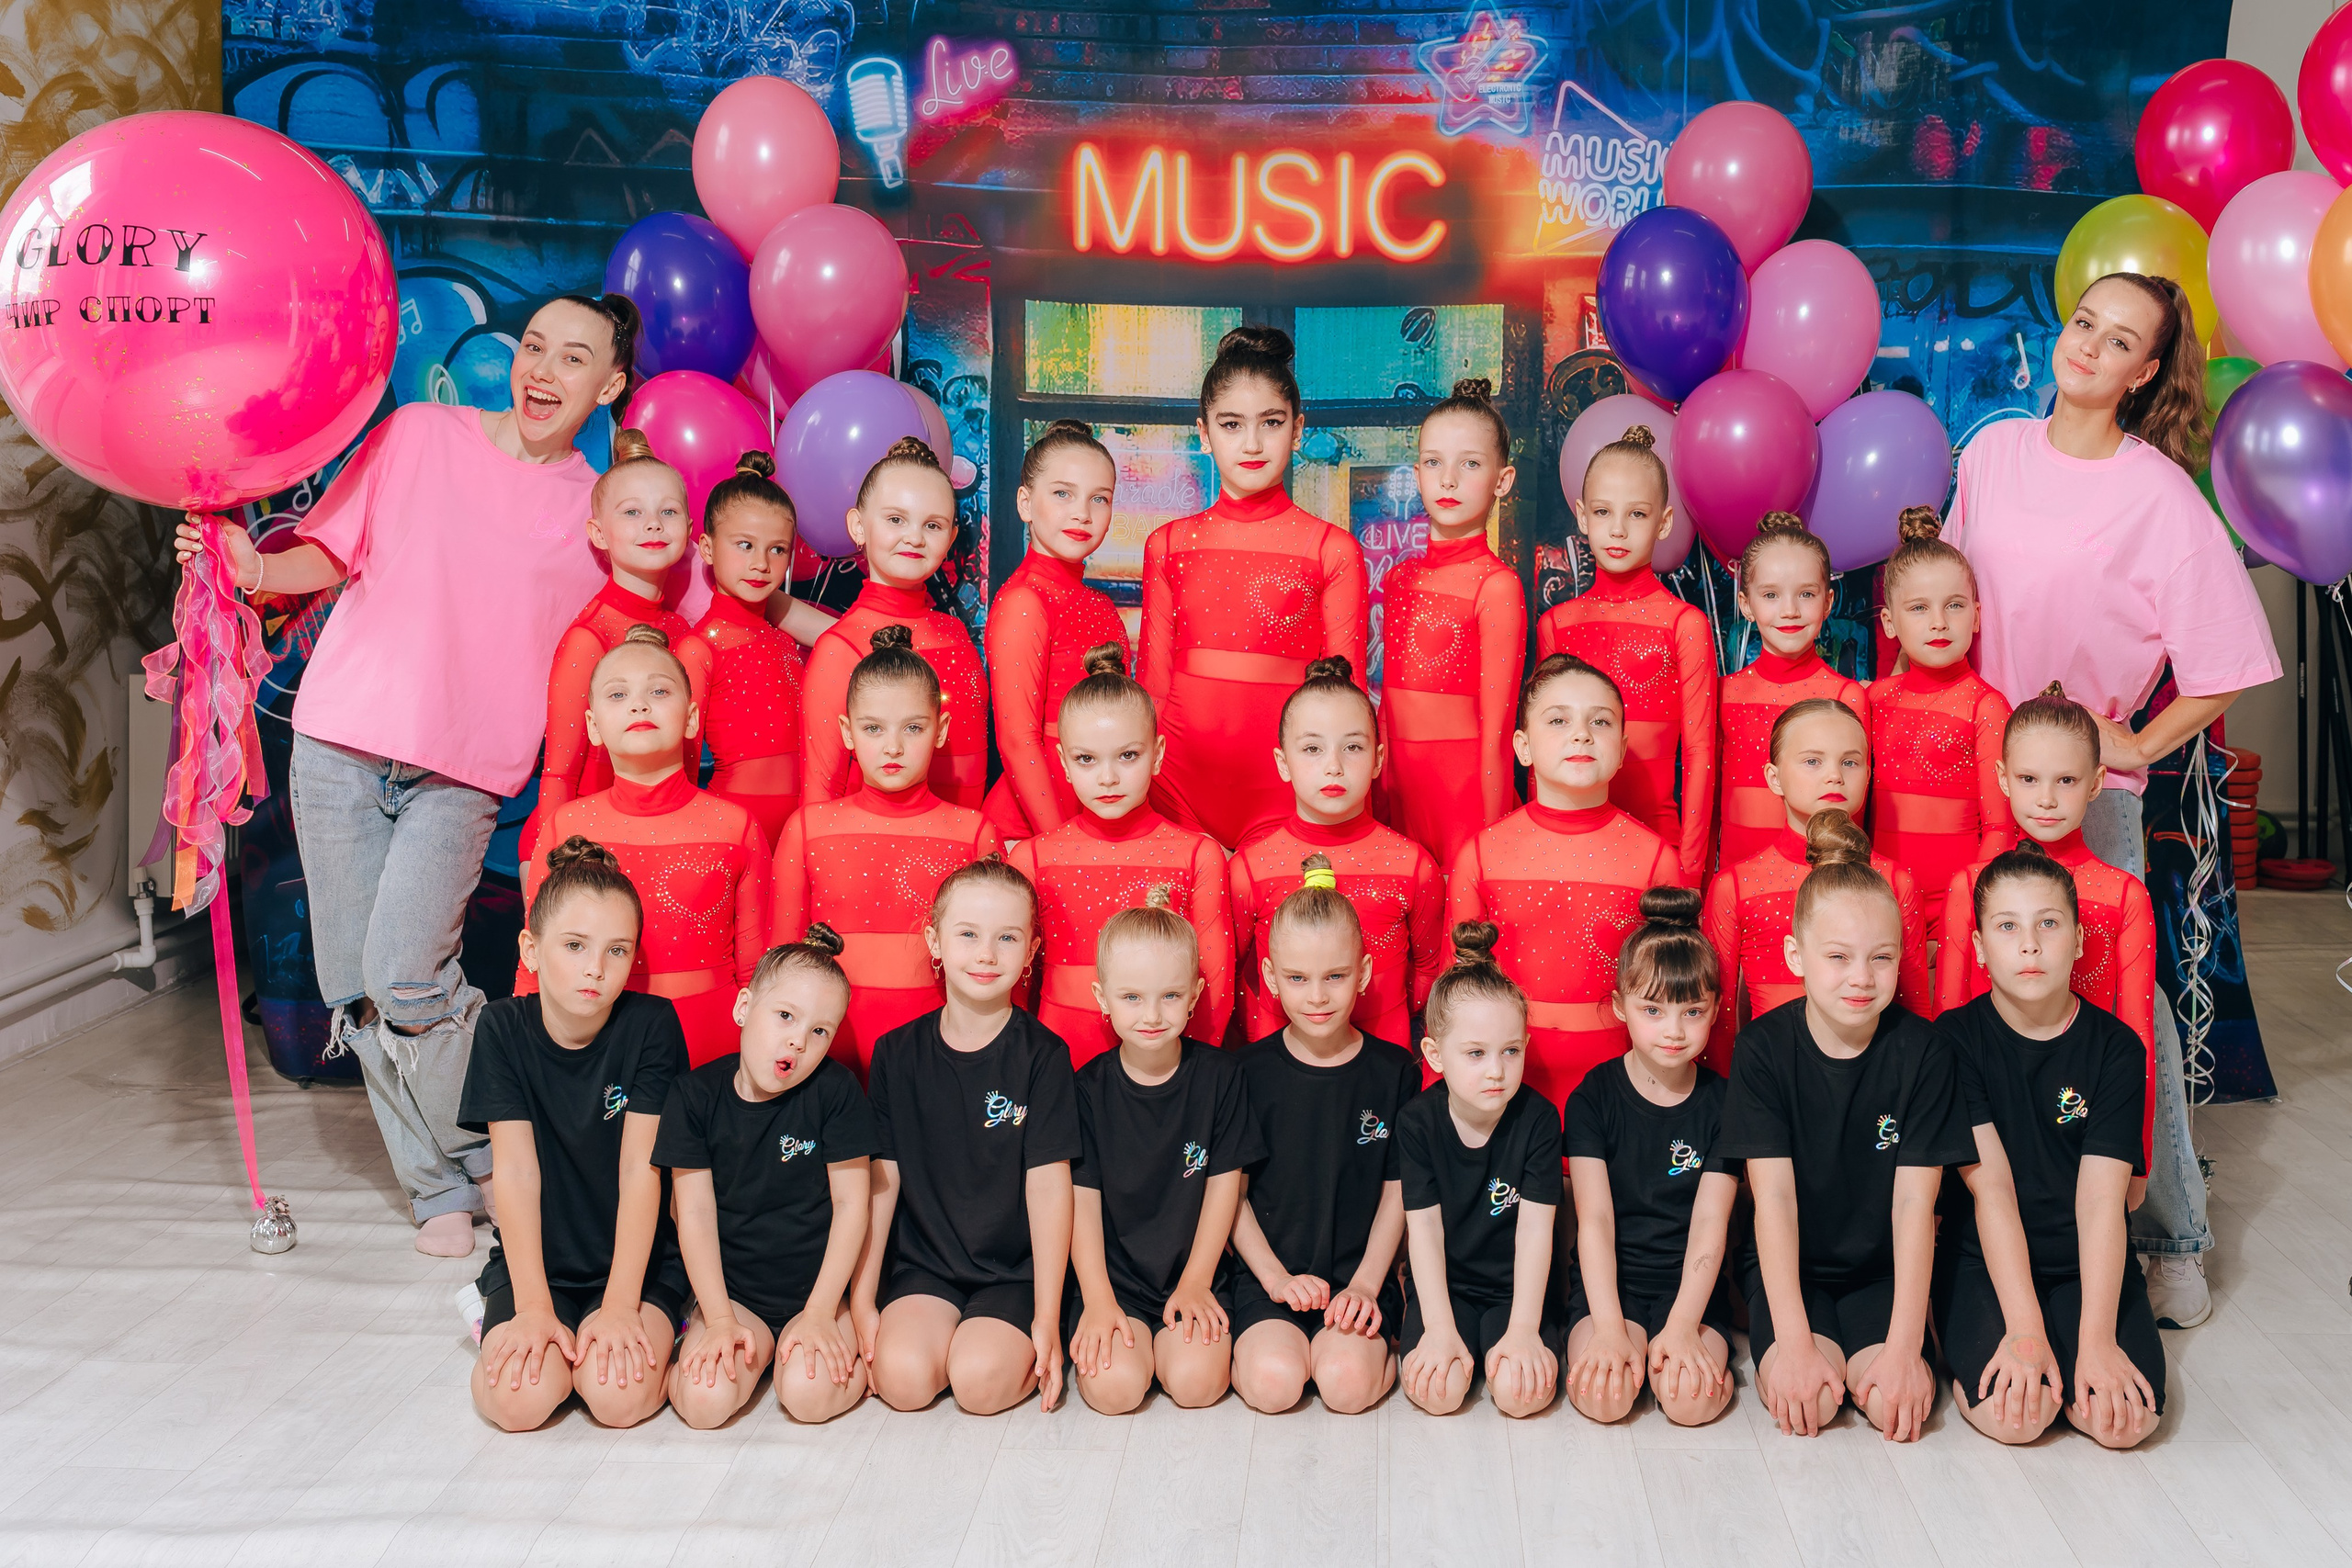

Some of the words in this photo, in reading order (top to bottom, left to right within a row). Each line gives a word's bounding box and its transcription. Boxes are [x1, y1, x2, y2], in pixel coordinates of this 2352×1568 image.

[922, 39, 1013, 116] Live
[1477, 84, 1522, 94] ELECTRONIC
[1488, 95, 1511, 104] MUSIC
[1541, 130, 1674, 186] MUSI
[1074, 143, 1445, 260] MUSIC
[1538, 178, 1666, 229] WOR
[16, 223, 208, 273] GLORY
[6, 299, 61, 330] ЧИР
[79, 295, 216, 324] СПОРТ
[1370, 523, 1429, 550] LIVE
[779, 1134, 817, 1163] Glory
